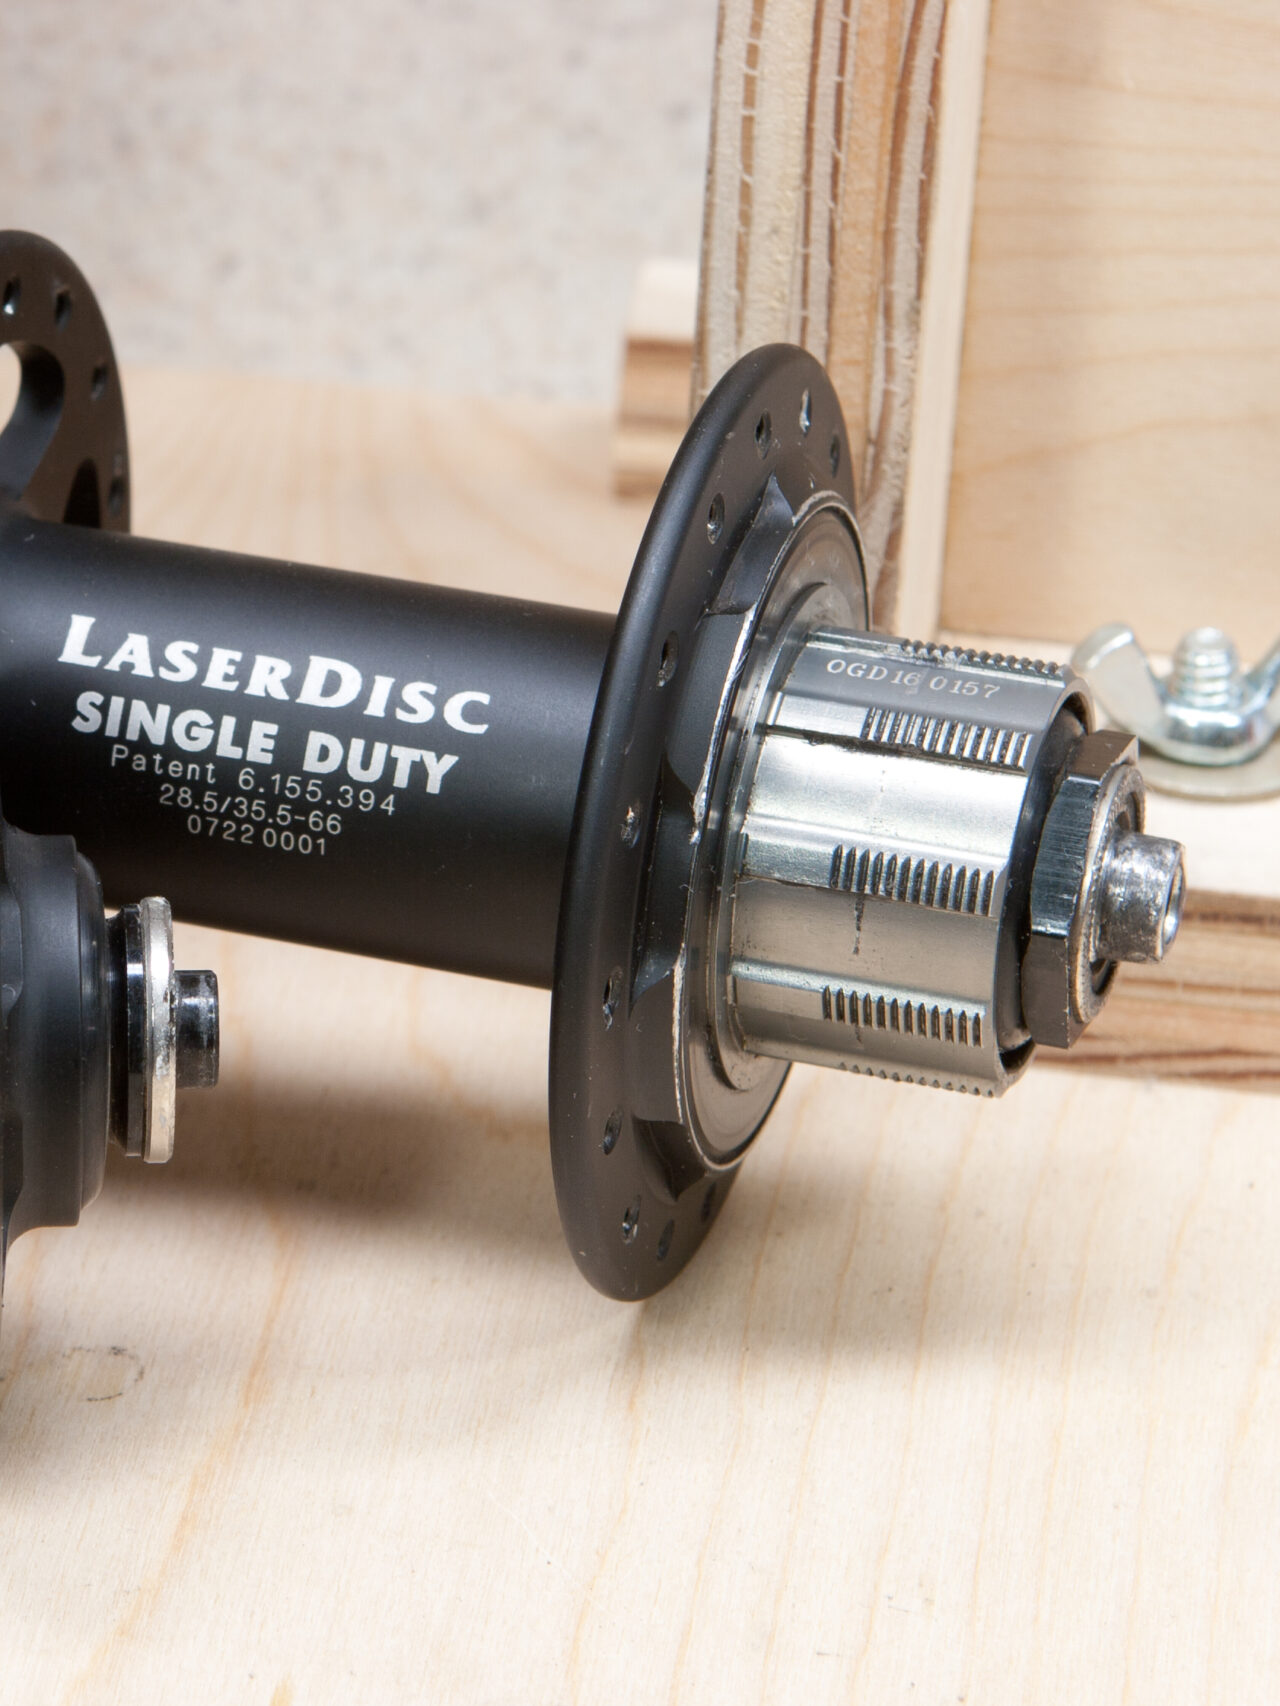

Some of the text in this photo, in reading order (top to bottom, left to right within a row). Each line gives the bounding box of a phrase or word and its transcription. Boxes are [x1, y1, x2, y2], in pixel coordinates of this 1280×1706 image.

[929, 676, 1000, 699] 0157
[72, 691, 459, 794] SINGLE DUTY
[111, 745, 396, 816] Patent 6.155.394
[160, 784, 342, 835] 28.5/35.5-66
